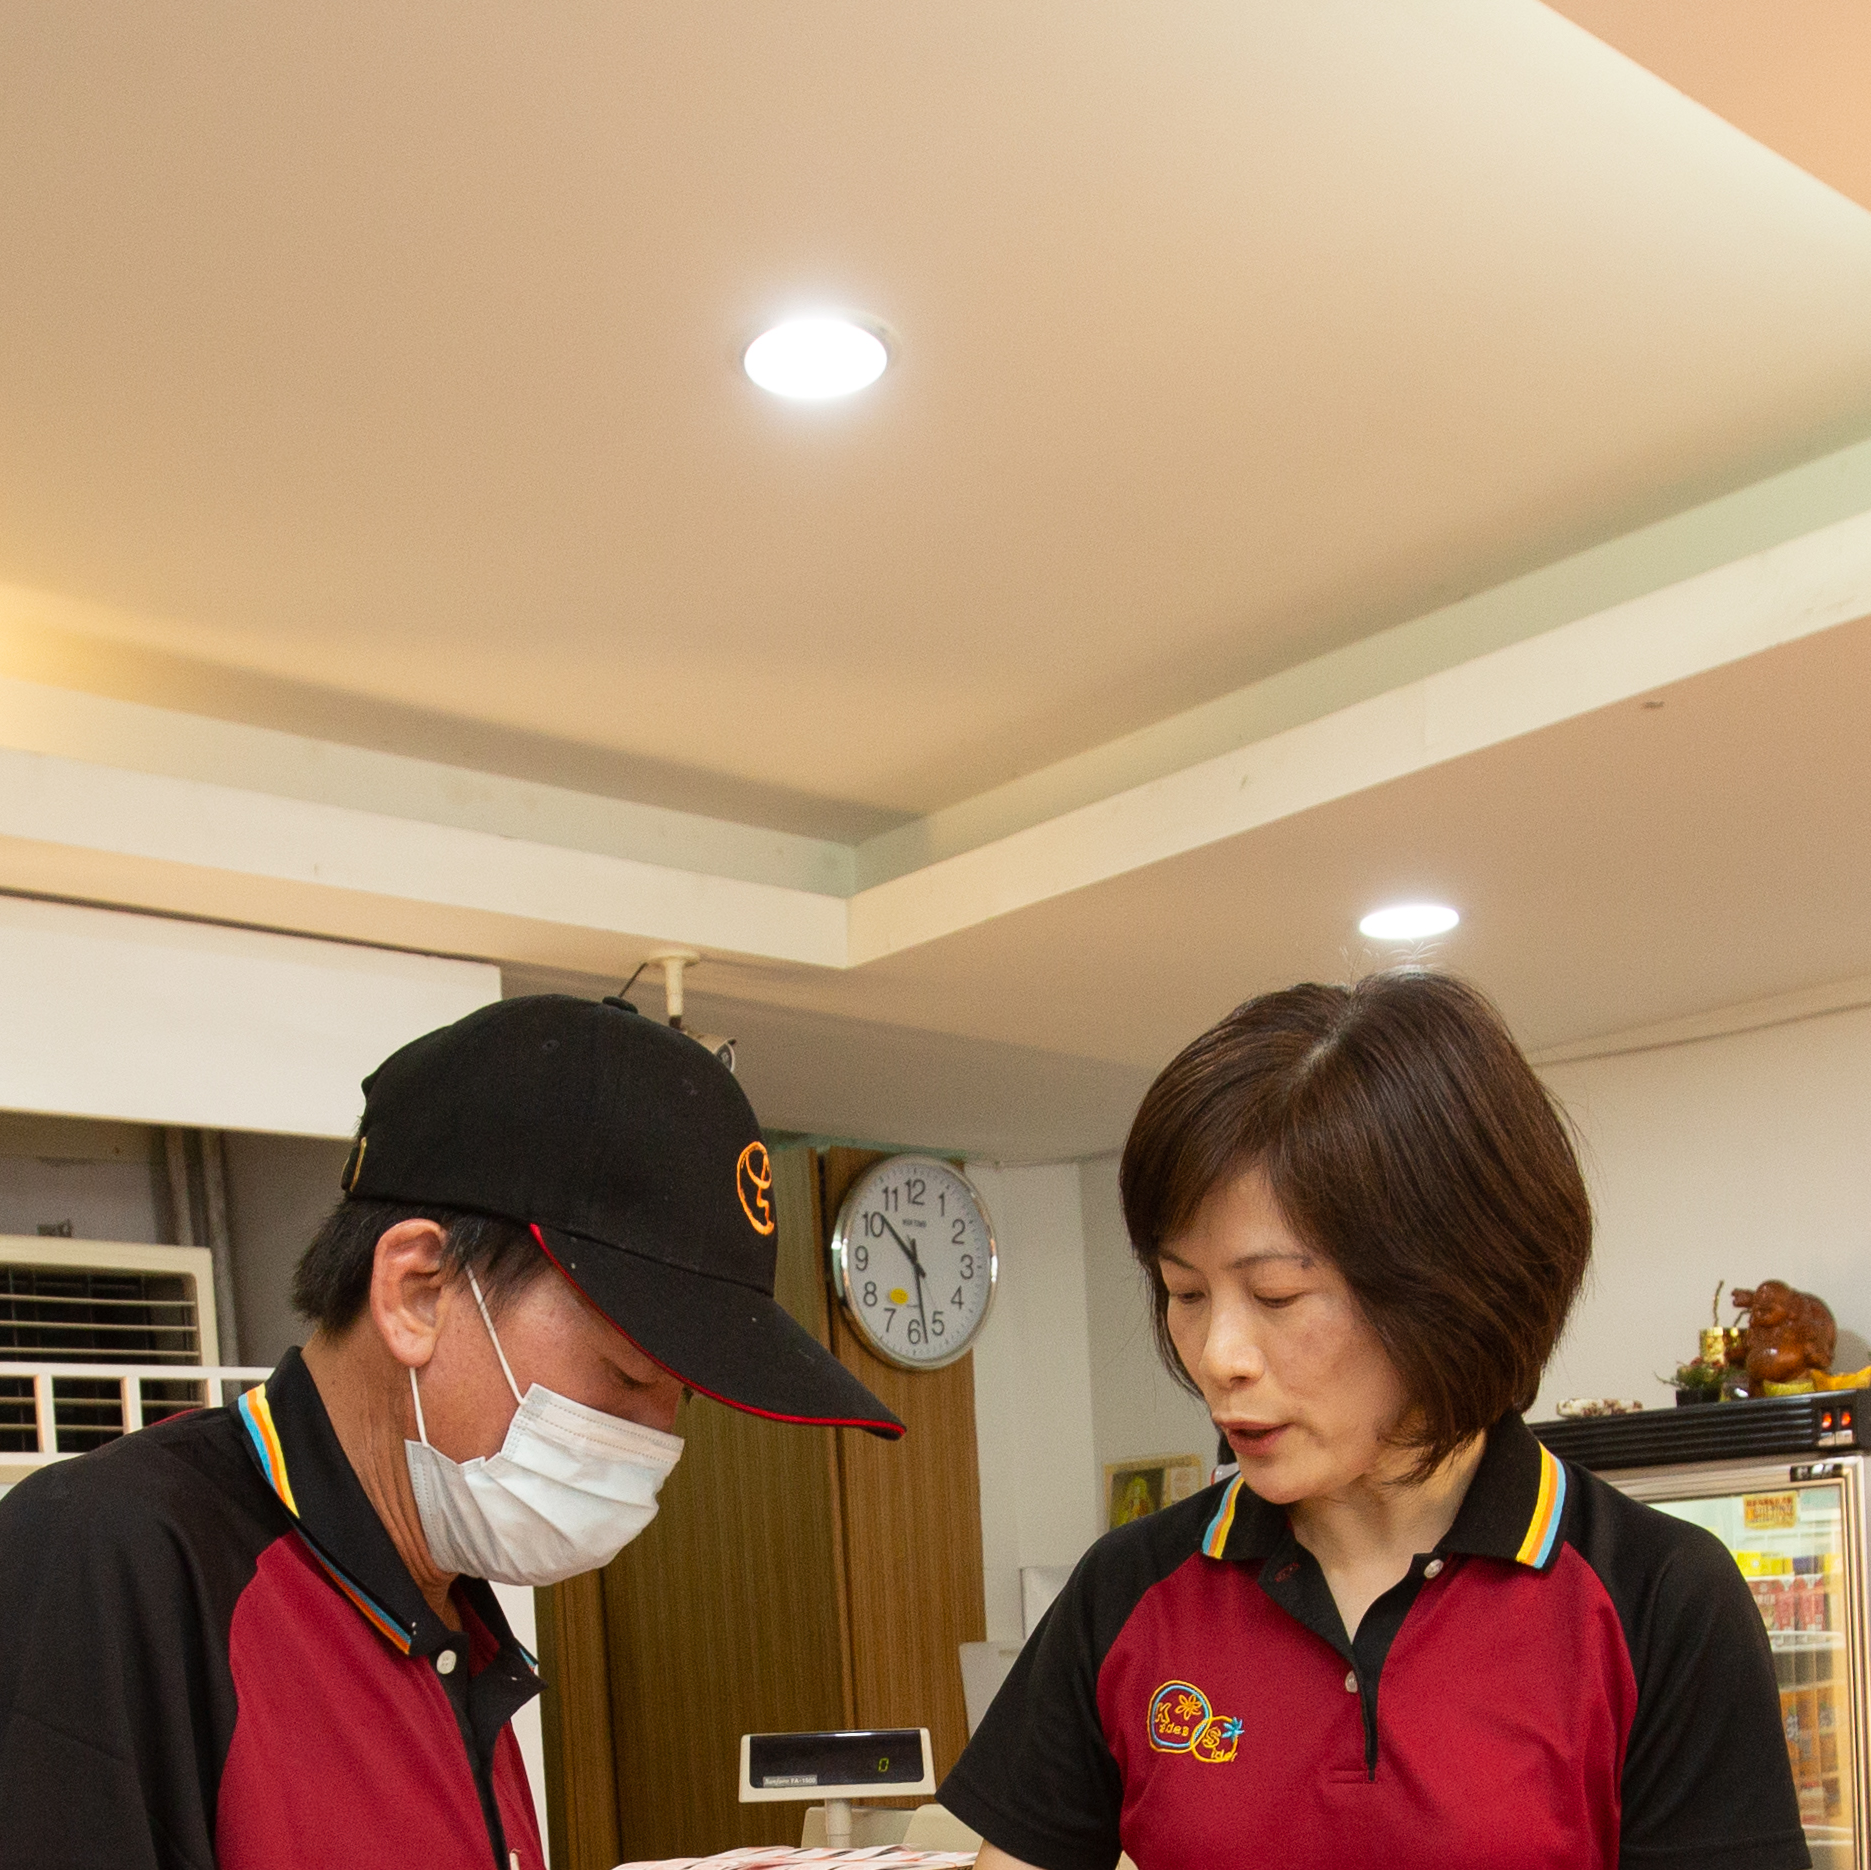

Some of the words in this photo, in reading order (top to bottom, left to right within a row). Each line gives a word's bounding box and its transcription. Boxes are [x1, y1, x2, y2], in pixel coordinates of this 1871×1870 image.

[882, 1186, 899, 1212] 11
[904, 1178, 926, 1205] 12
[938, 1192, 946, 1217] 1
[862, 1211, 884, 1237] 10
[951, 1218, 966, 1244] 2
[854, 1245, 869, 1271] 9
[960, 1254, 974, 1280] 3
[863, 1281, 878, 1307] 8
[950, 1286, 964, 1310] 4
[883, 1308, 897, 1333] 7
[907, 1319, 921, 1344] 6
[931, 1310, 945, 1336] 5
[878, 1757, 889, 1773] 0
